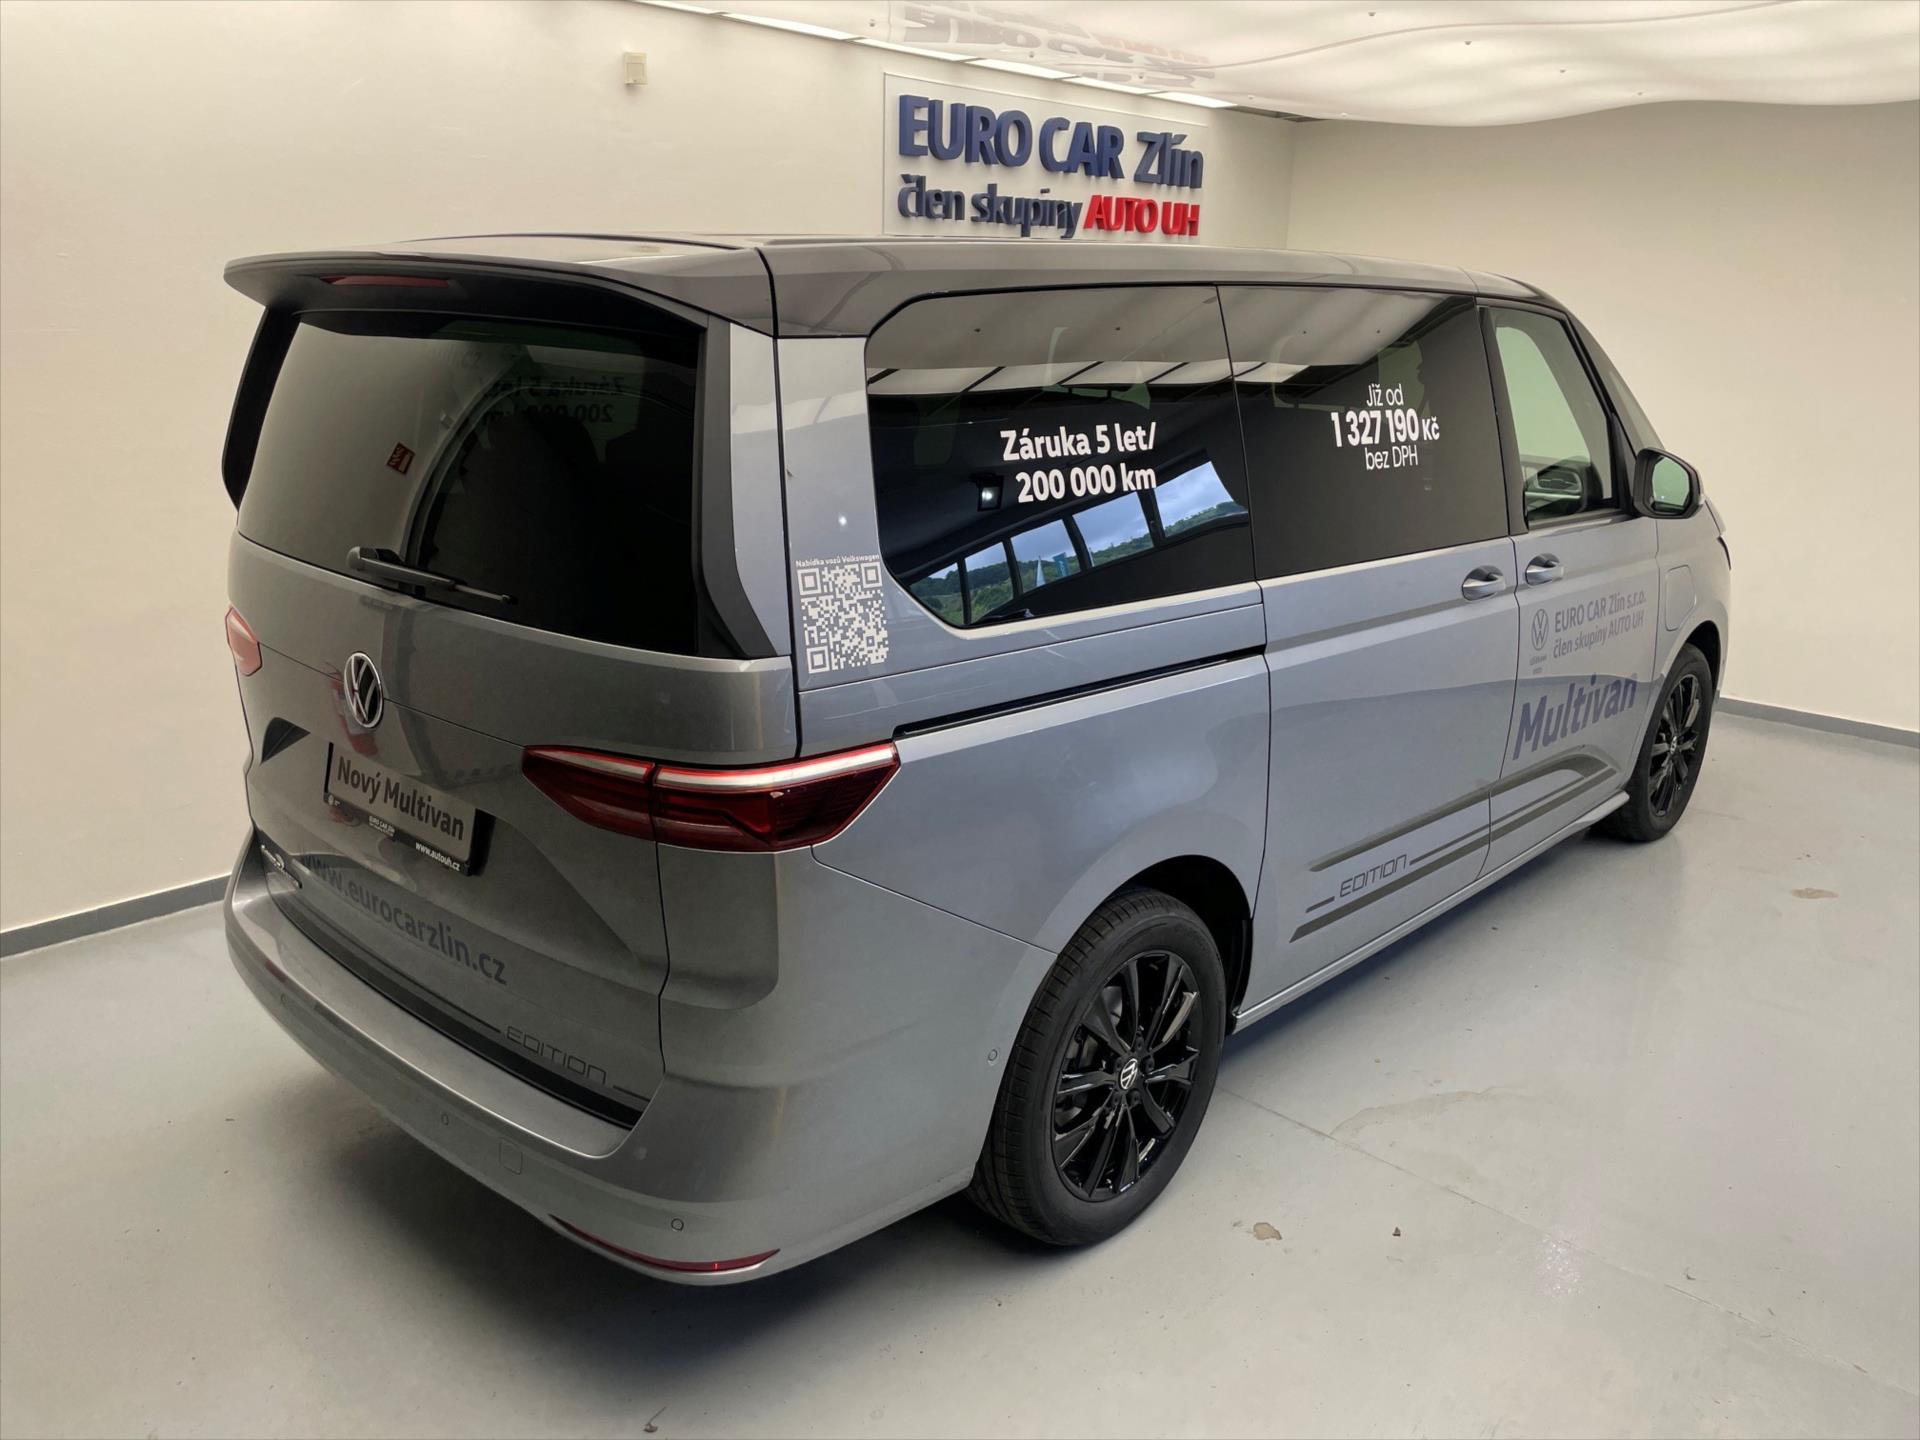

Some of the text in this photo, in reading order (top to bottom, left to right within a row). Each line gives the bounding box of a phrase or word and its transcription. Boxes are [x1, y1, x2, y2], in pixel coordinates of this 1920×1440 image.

[899, 94, 1204, 189] EURO CAR Zlín
[898, 173, 1200, 239] člen skupiny AUTO UH
[1366, 383, 1404, 408] Již od
[1000, 422, 1158, 461] Záruka 5 let/
[1331, 407, 1440, 448] 1 327 190 Kč
[1365, 443, 1419, 471] bez DPH
[1016, 462, 1158, 504] 200 000 km
[841, 554, 880, 563] Volkswagen
[1554, 590, 1647, 633] EURO CAR Zlín s.r.o.
[1553, 610, 1645, 658] člen skupiny AUTO UH
[1512, 673, 1638, 760] Multivan
[337, 755, 464, 840] Nový Multivan
[415, 842, 461, 871] www.autouh.cz
[1339, 854, 1407, 898] EDITION
[506, 1024, 607, 1086] EDITION
